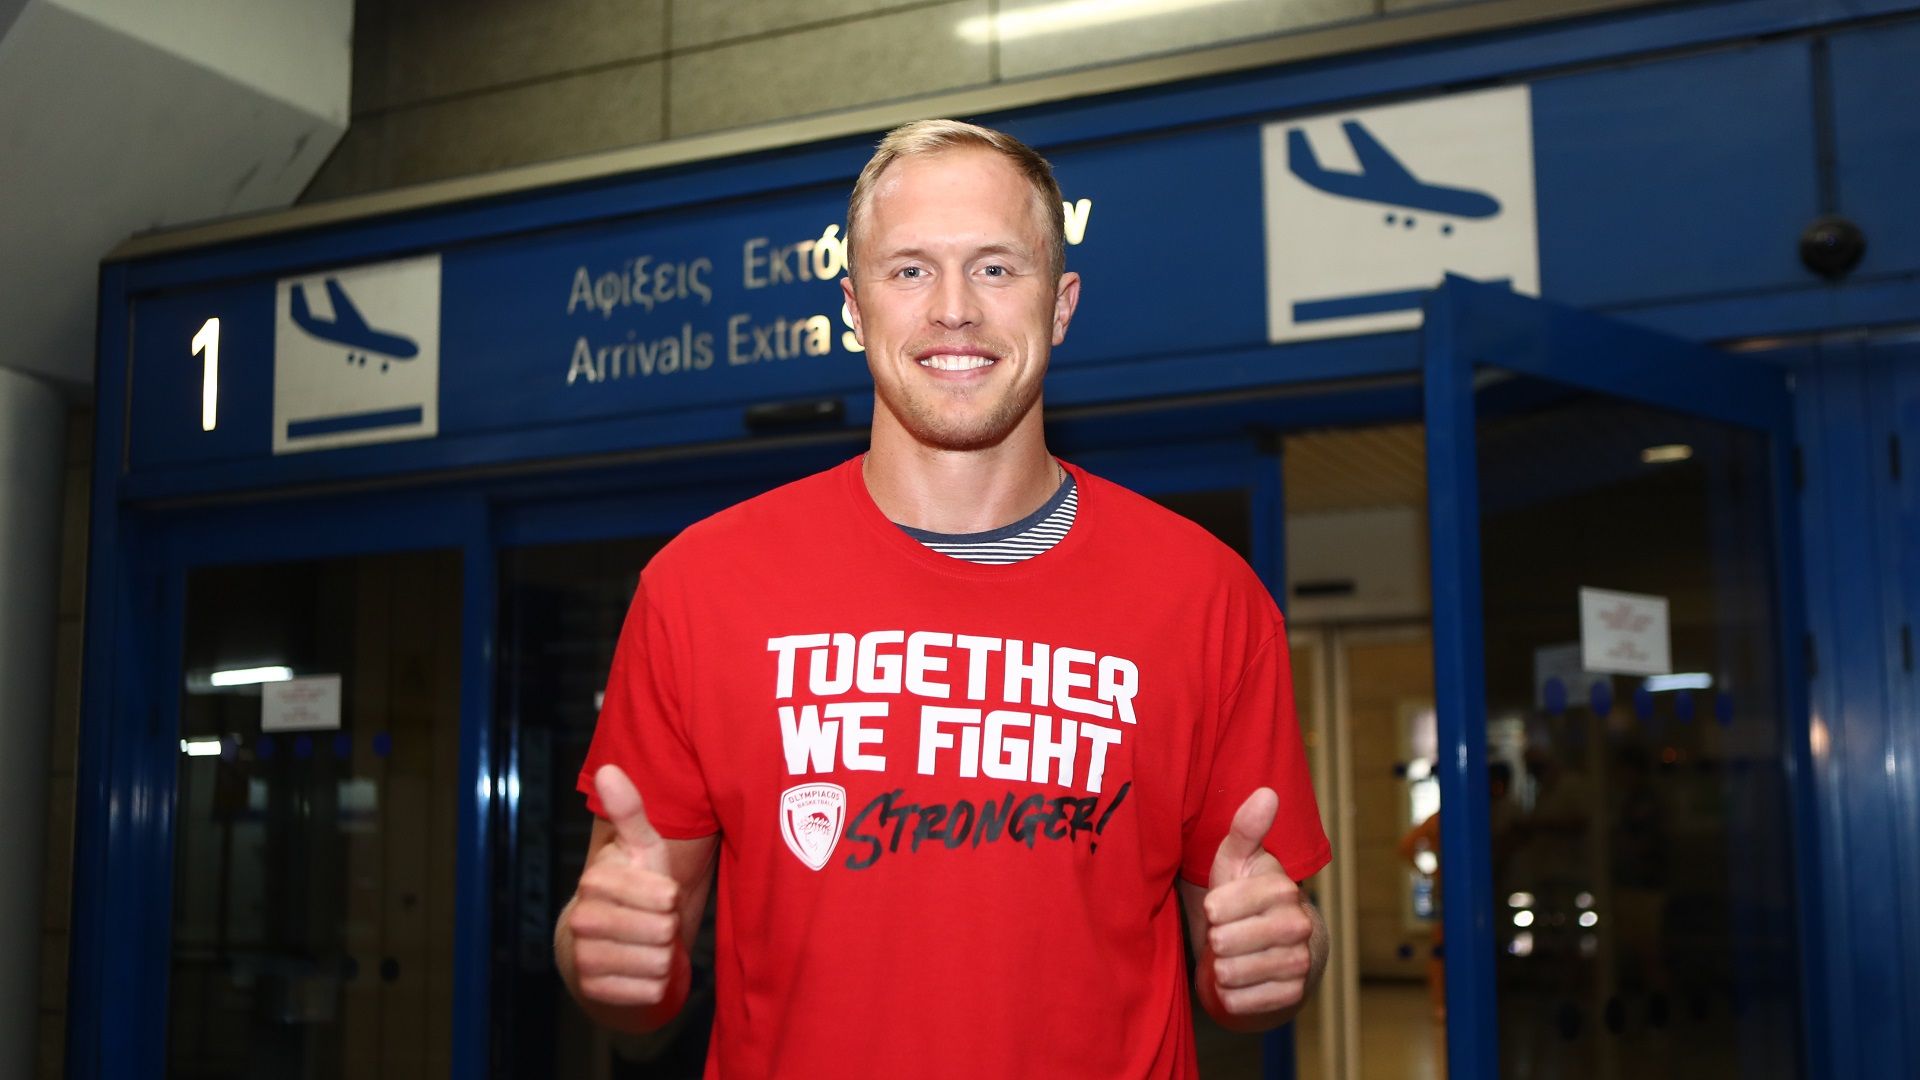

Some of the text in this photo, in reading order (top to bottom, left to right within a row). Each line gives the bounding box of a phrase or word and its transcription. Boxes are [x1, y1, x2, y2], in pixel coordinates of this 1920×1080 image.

[568, 256, 713, 318] Αφίξεις
[192, 317, 220, 431] 1
[567, 323, 714, 385] Arrivals
[728, 313, 831, 366] Extra
[767, 630, 1139, 724] TOGETHER
[778, 702, 1122, 793] WE FIGHT
[788, 790, 840, 803] OLYMPIACOS
[844, 780, 1132, 871] STRONGER!
